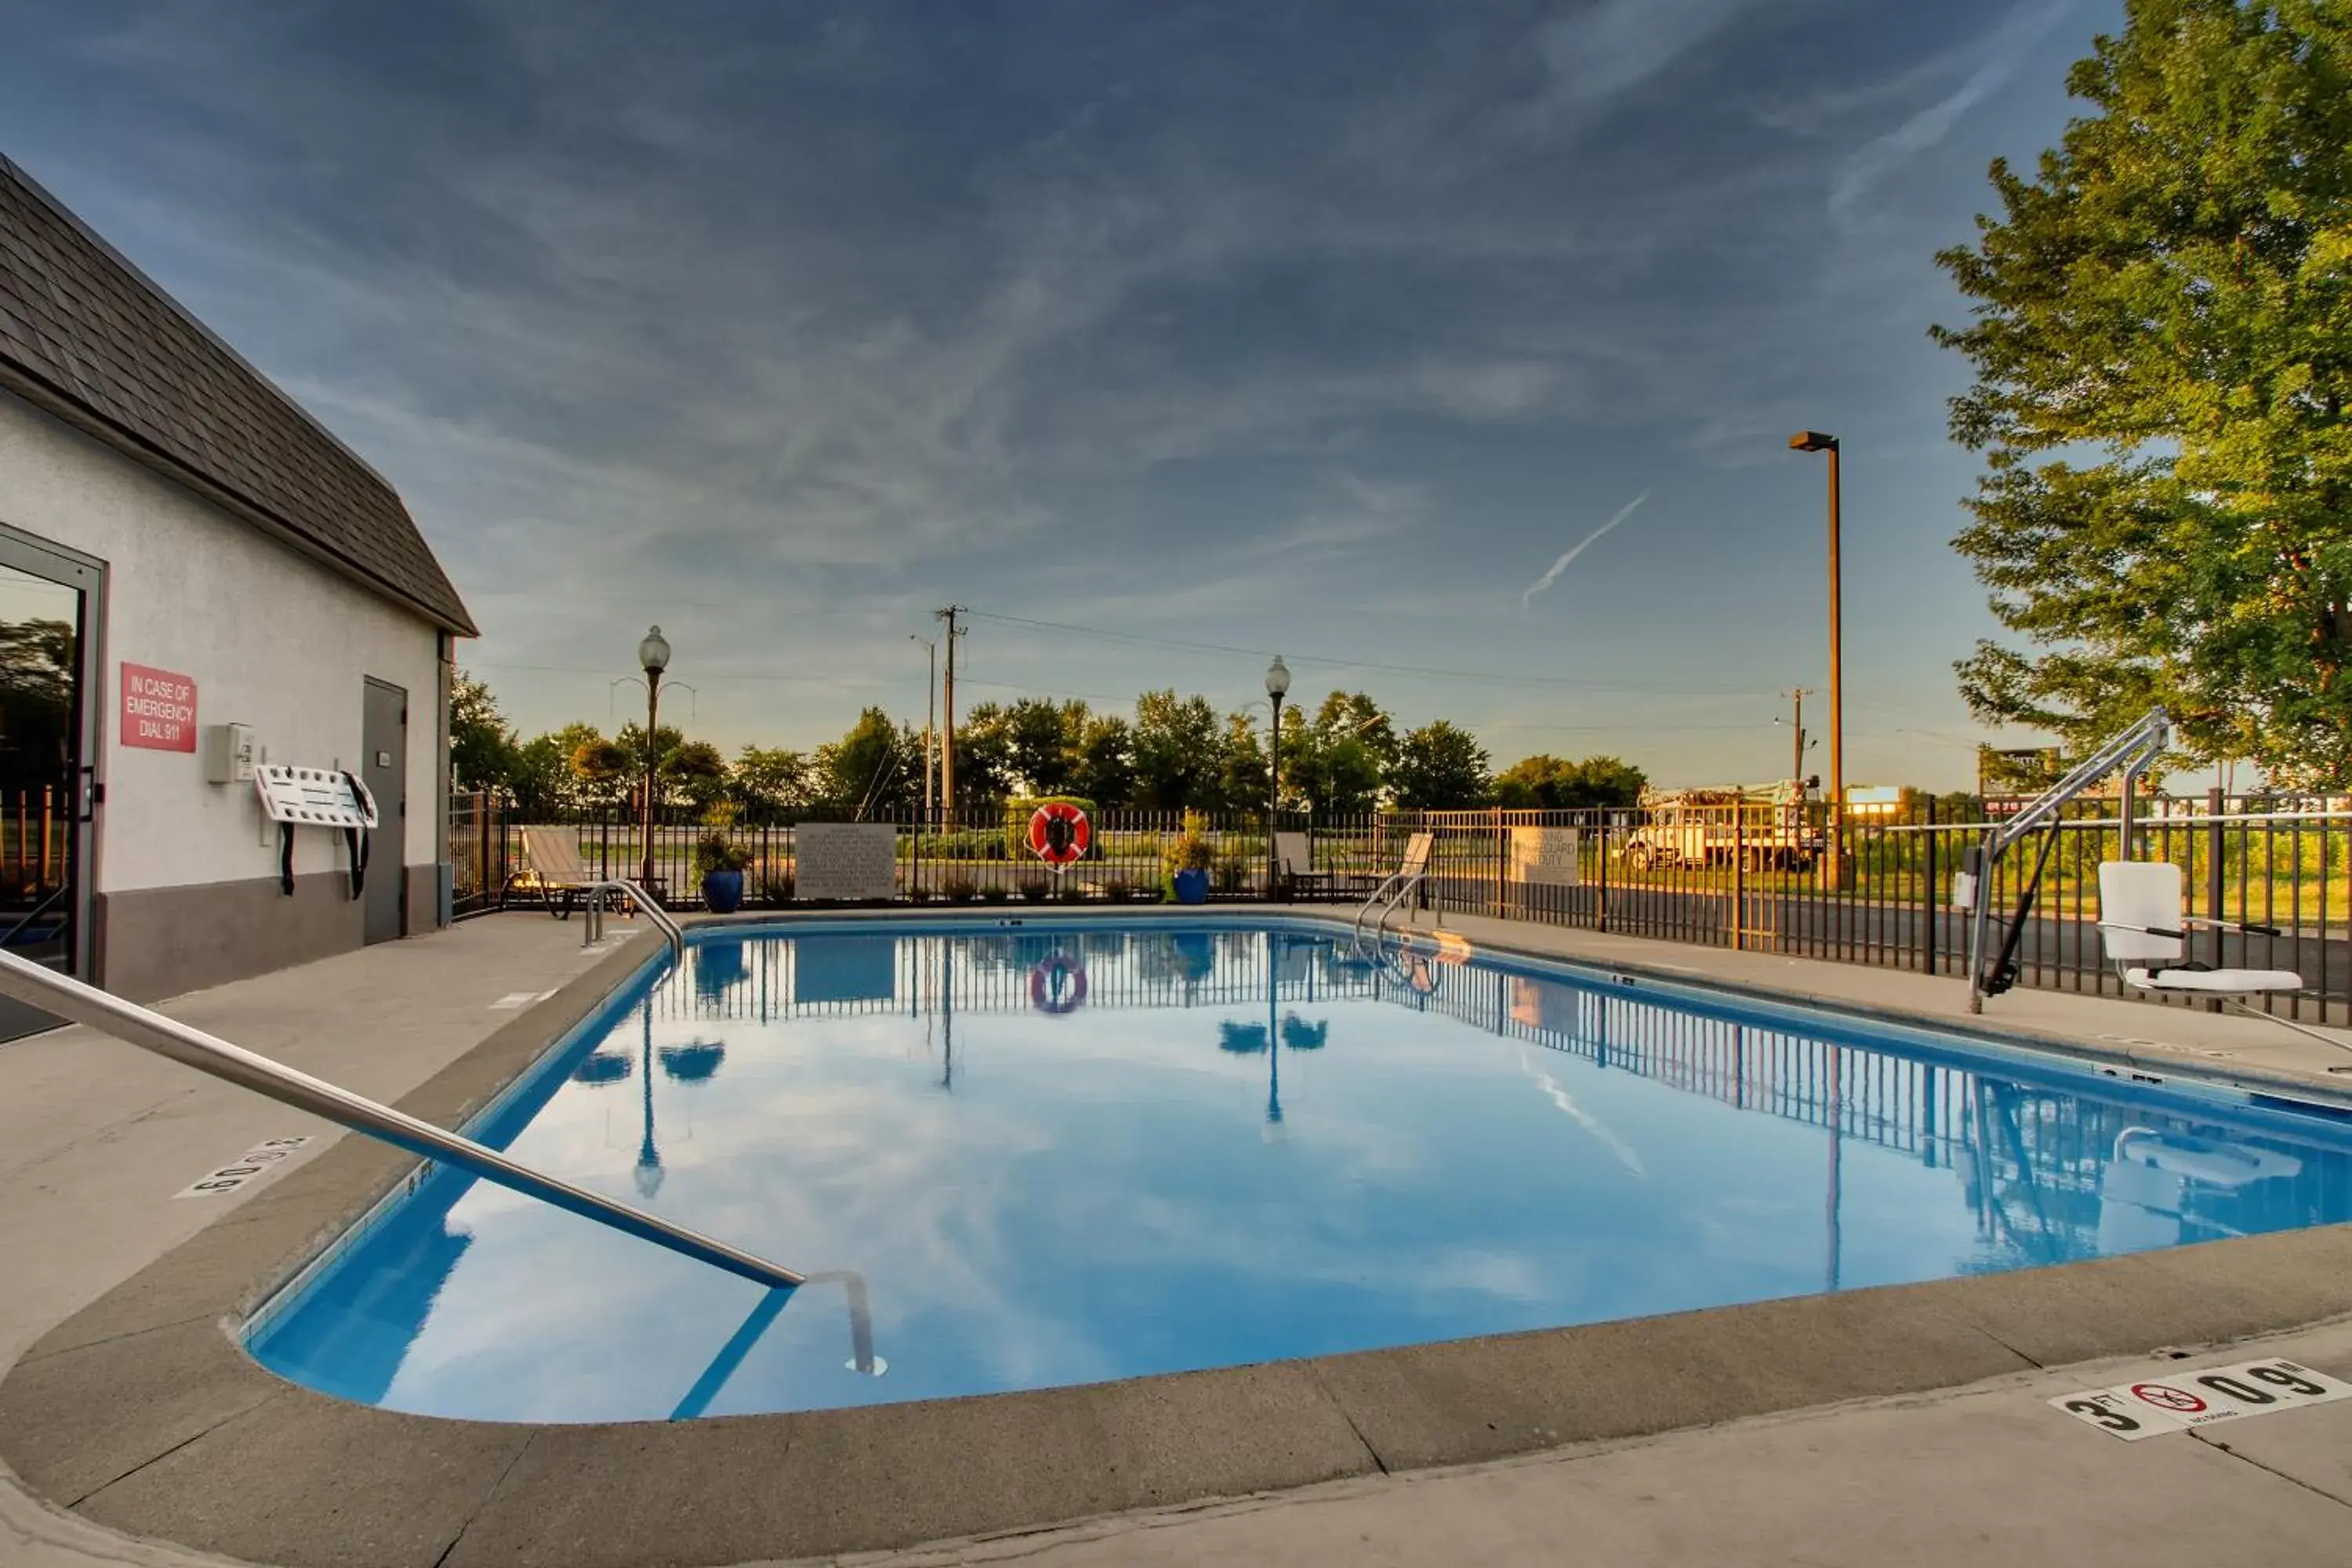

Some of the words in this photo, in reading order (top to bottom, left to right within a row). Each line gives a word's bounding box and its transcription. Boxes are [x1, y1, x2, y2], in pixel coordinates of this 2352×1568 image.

[131, 676, 143, 692] IN
[145, 678, 173, 699] CASE
[176, 684, 189, 702] OF
[127, 696, 194, 722] EMERGENCY
[139, 719, 163, 739] DIAL
[165, 724, 180, 741] 911
[2065, 1401, 2140, 1431] 3
